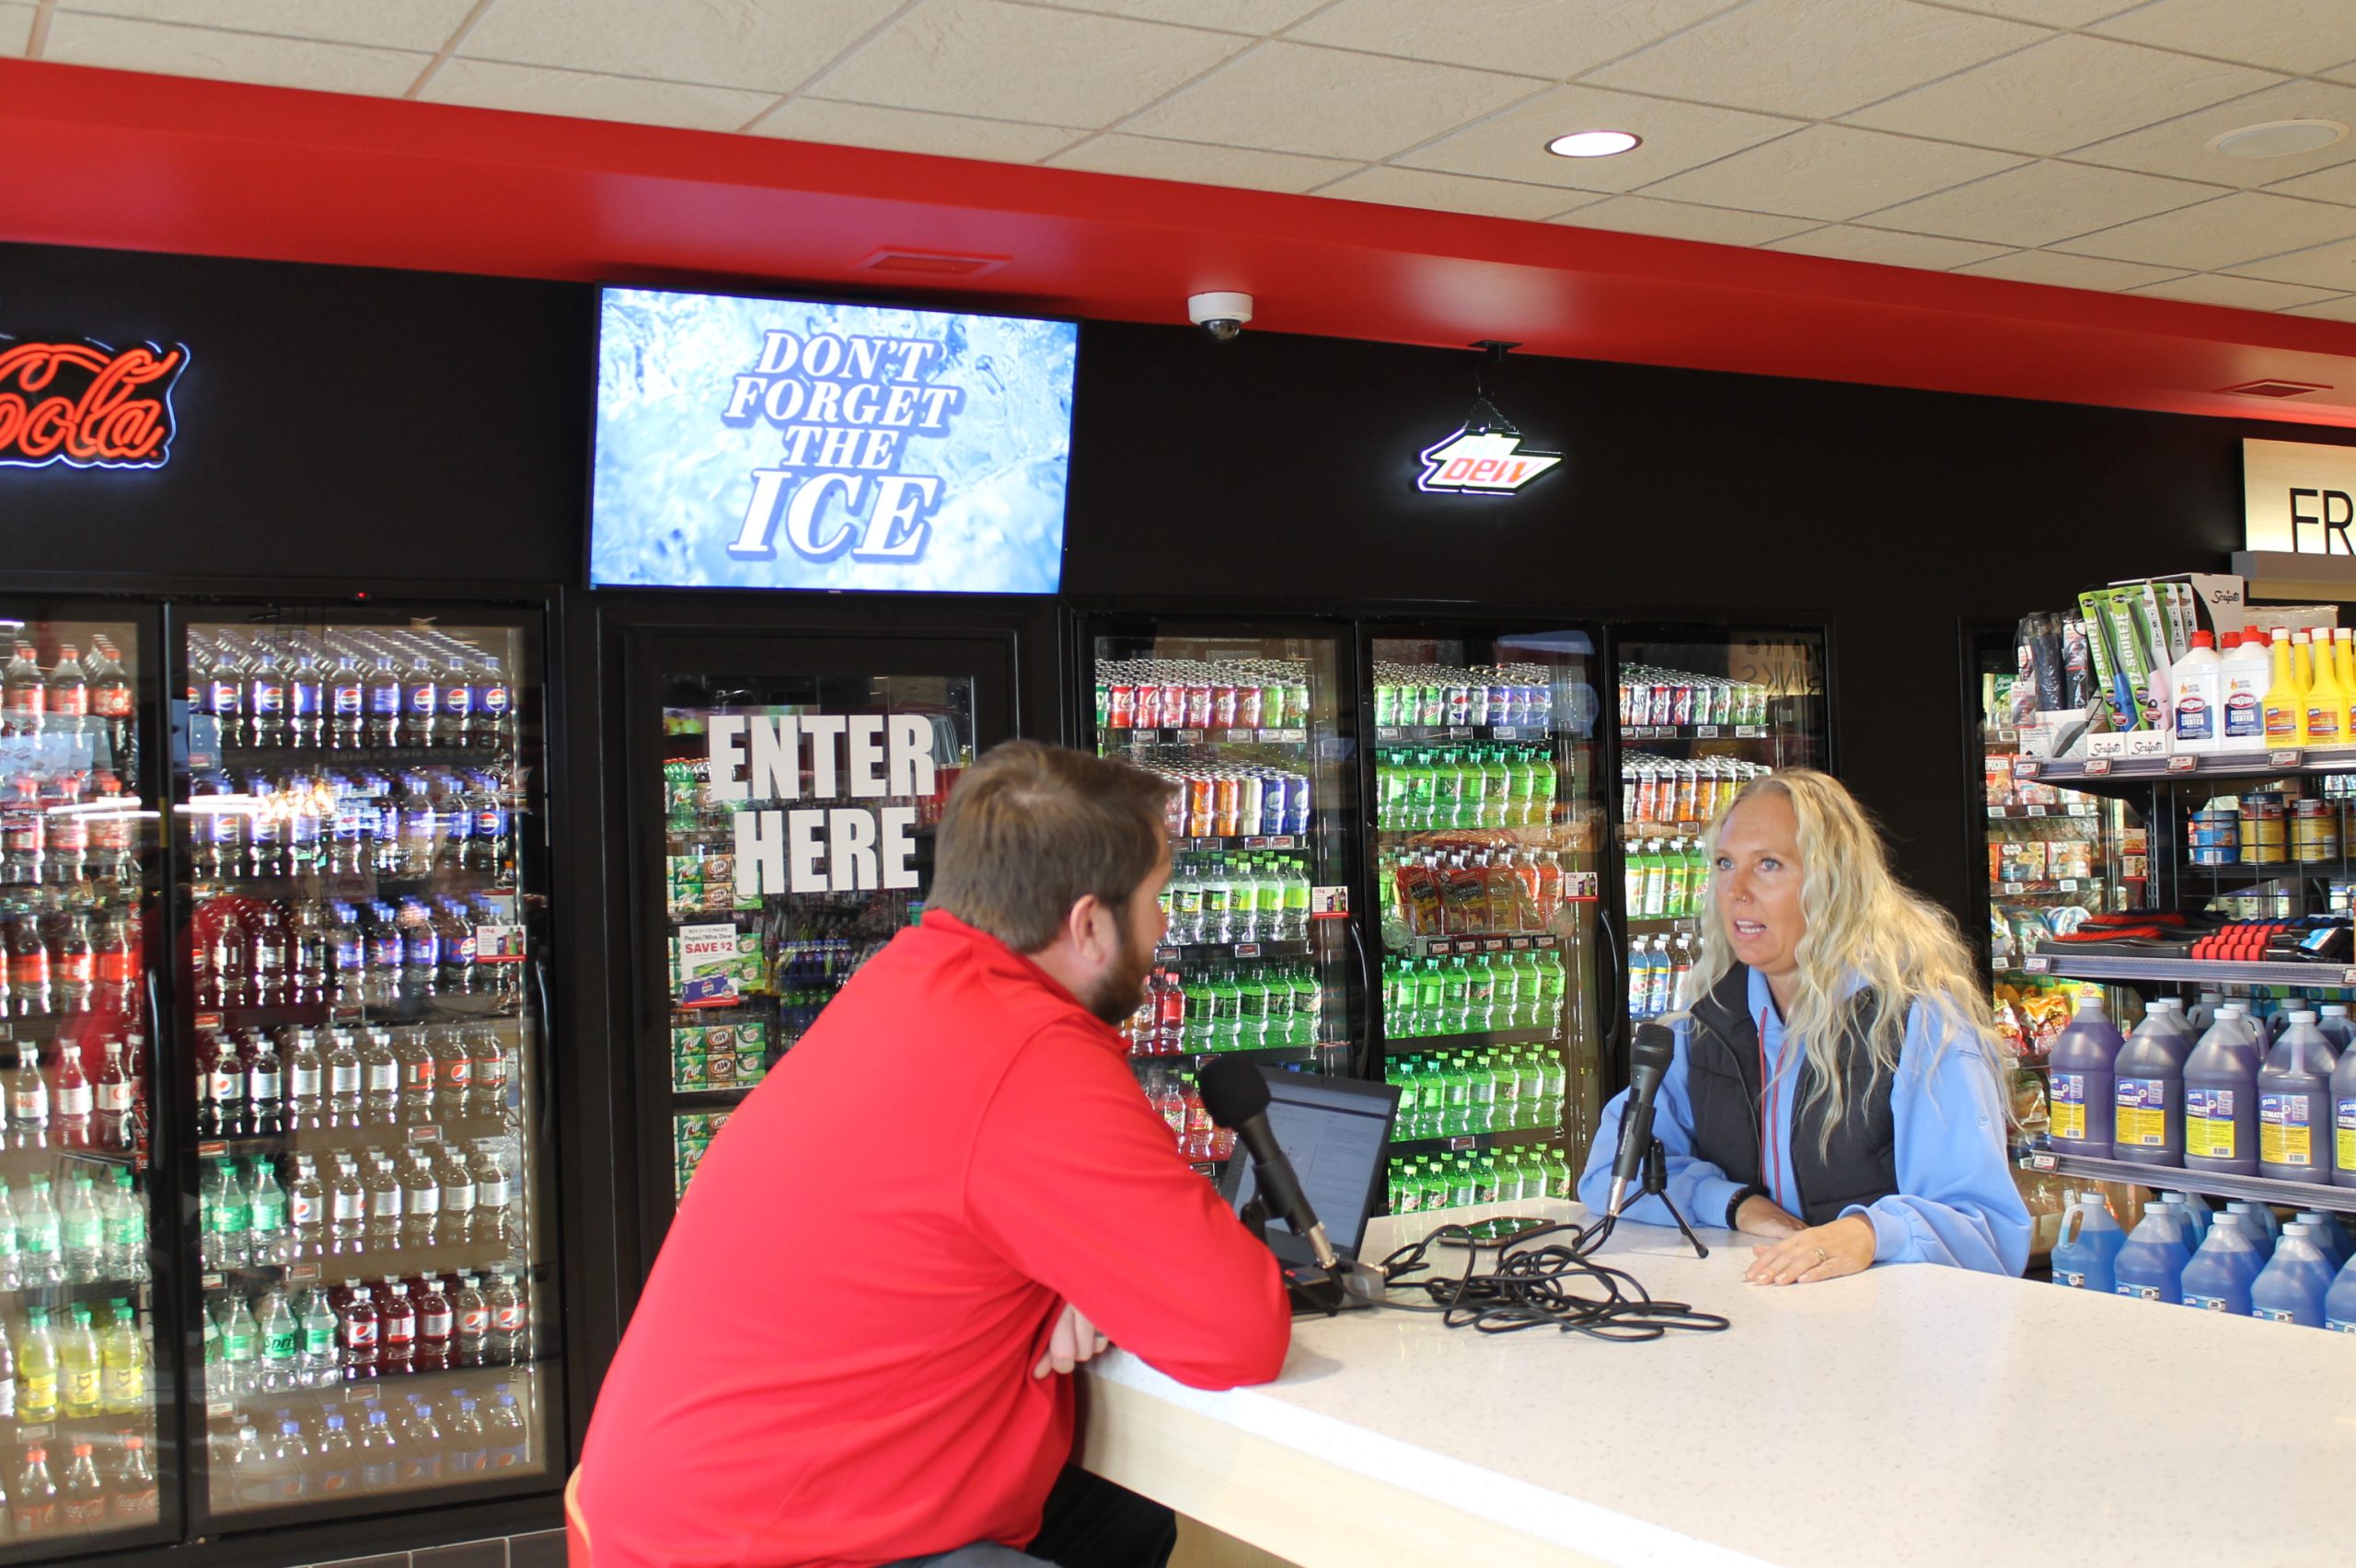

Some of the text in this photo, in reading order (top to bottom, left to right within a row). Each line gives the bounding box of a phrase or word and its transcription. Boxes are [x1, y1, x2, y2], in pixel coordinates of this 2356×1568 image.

[753, 329, 936, 383] DON'T
[723, 375, 959, 429] FORGET
[782, 424, 901, 471] THE
[728, 468, 940, 557] ICE
[2289, 487, 2356, 556] FR
[2211, 590, 2241, 605] Scripto
[708, 714, 935, 800] ENTER
[2090, 742, 2121, 756] Scripto
[2131, 741, 2163, 755] Scripto
[734, 807, 919, 894] HERE
[685, 940, 733, 954] SAVE $2
